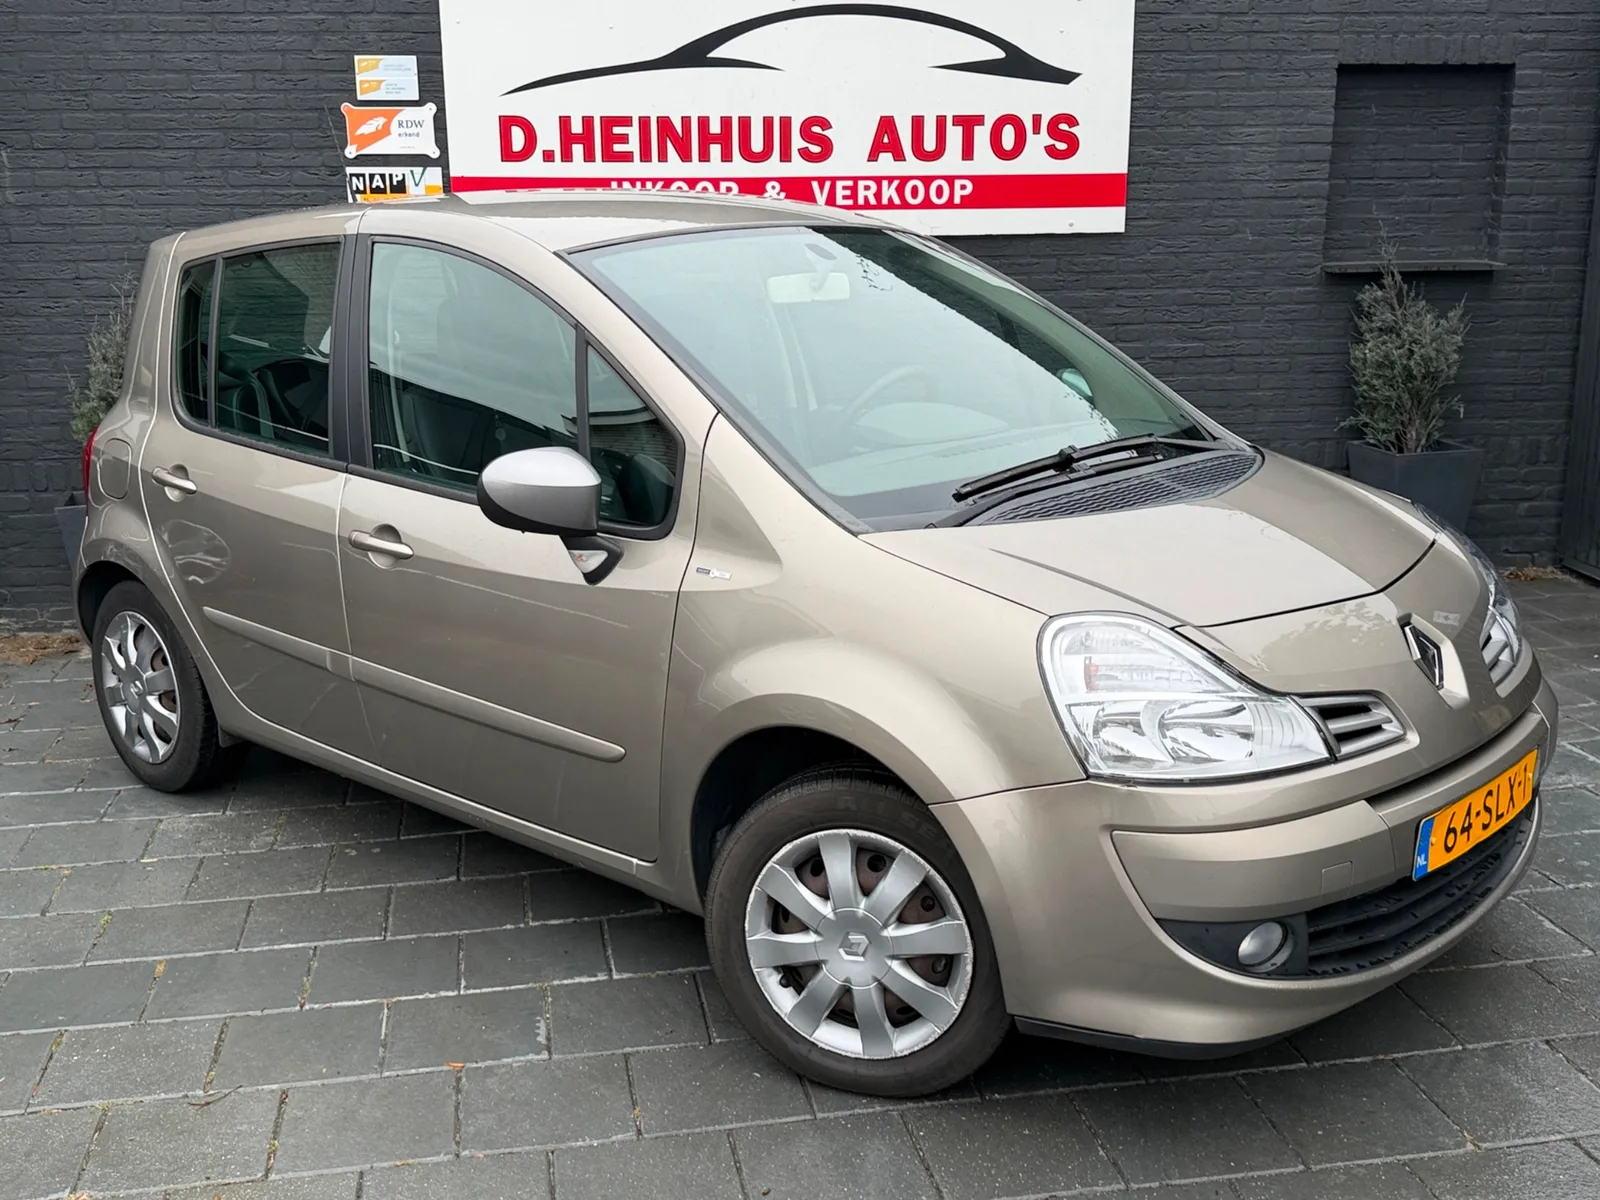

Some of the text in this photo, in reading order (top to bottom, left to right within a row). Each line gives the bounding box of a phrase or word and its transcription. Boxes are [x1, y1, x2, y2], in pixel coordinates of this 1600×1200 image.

[397, 119, 425, 129] RDW
[498, 112, 1080, 163] D.HEINHUIS AUTO'S
[764, 180, 786, 200] &
[811, 178, 974, 206] VERKOOP
[1443, 762, 1528, 854] 64-SLX-1
[1416, 853, 1427, 868] NL
